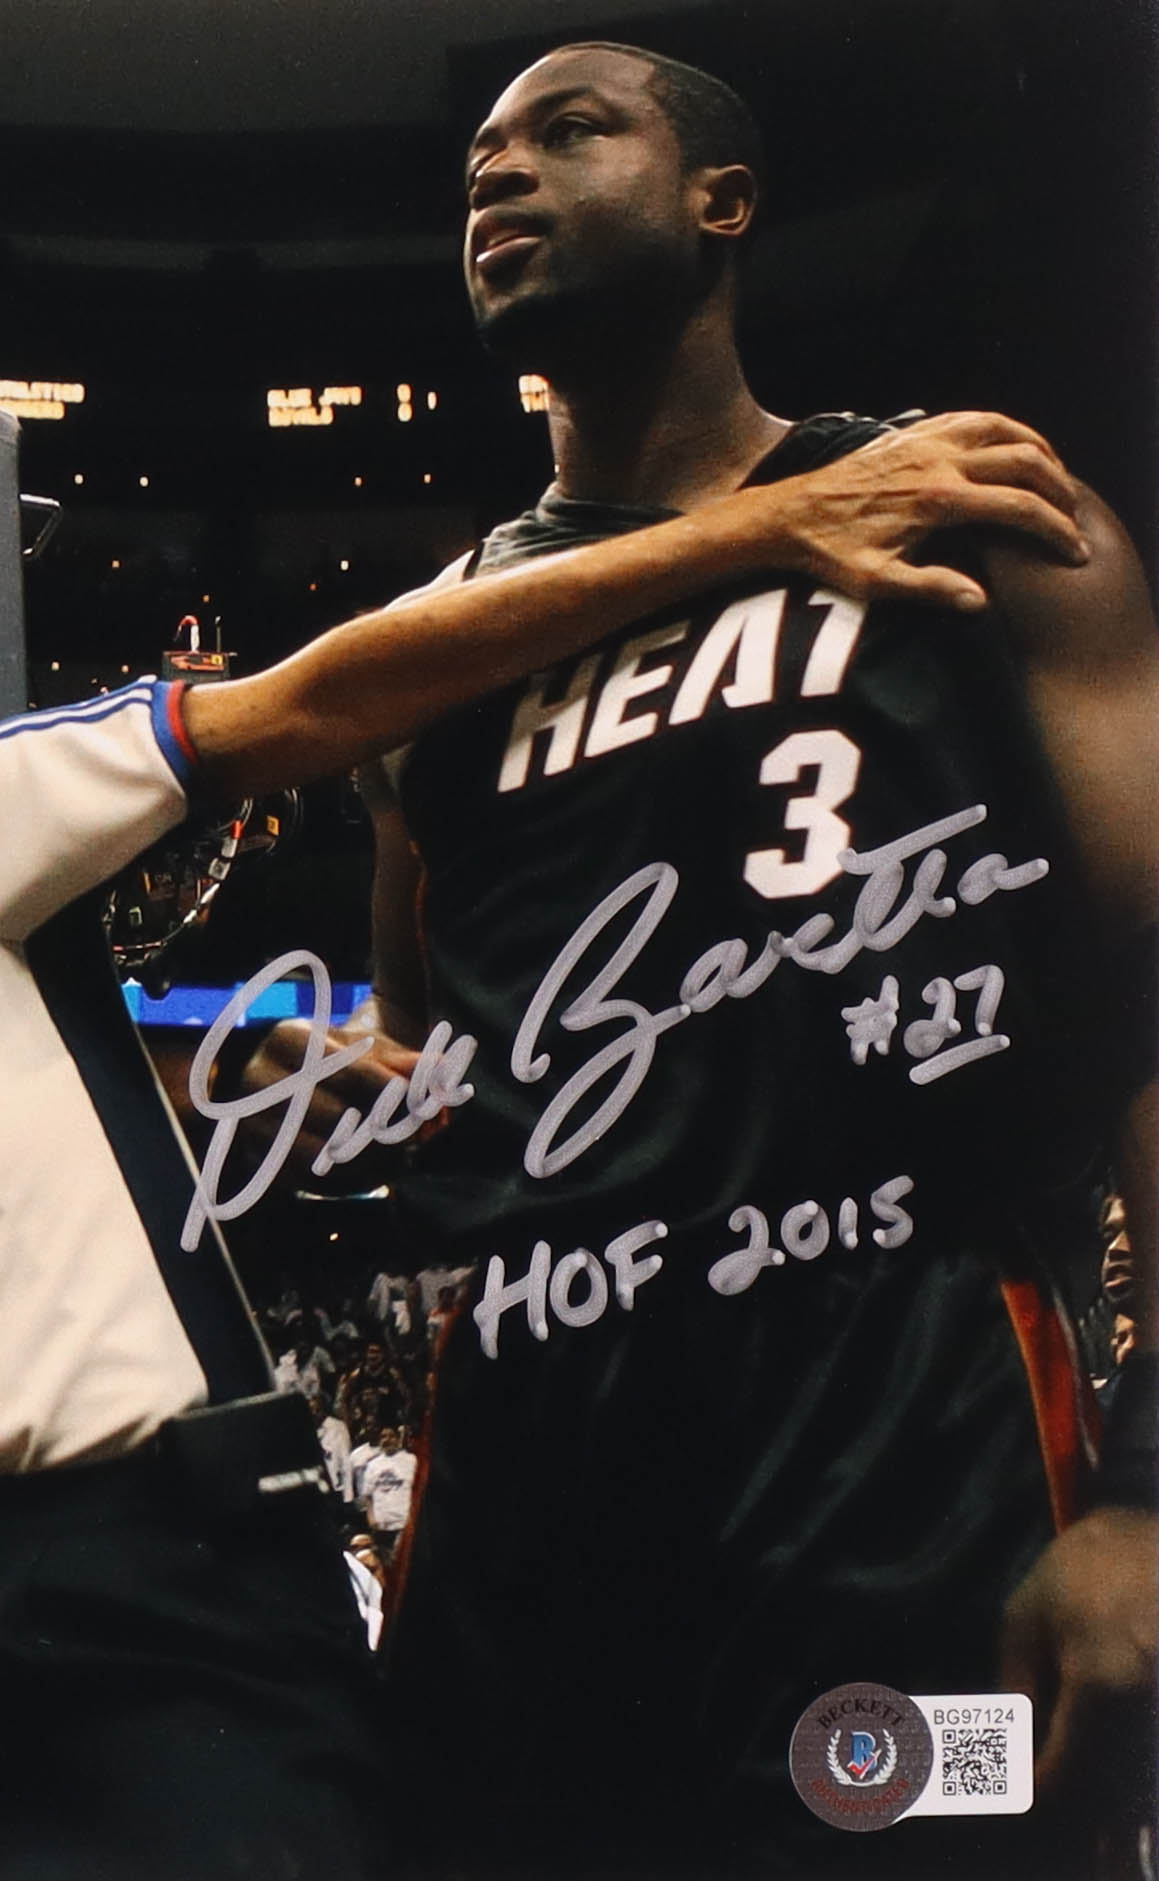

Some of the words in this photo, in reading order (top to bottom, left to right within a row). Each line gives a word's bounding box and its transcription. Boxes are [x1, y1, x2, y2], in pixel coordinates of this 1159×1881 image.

[498, 588, 870, 793] HEAT
[743, 728, 862, 899] 3
[473, 1221, 668, 1360] HOF
[816, 1698, 906, 1730] BECKETT
[933, 1708, 1015, 1726] BG97124
